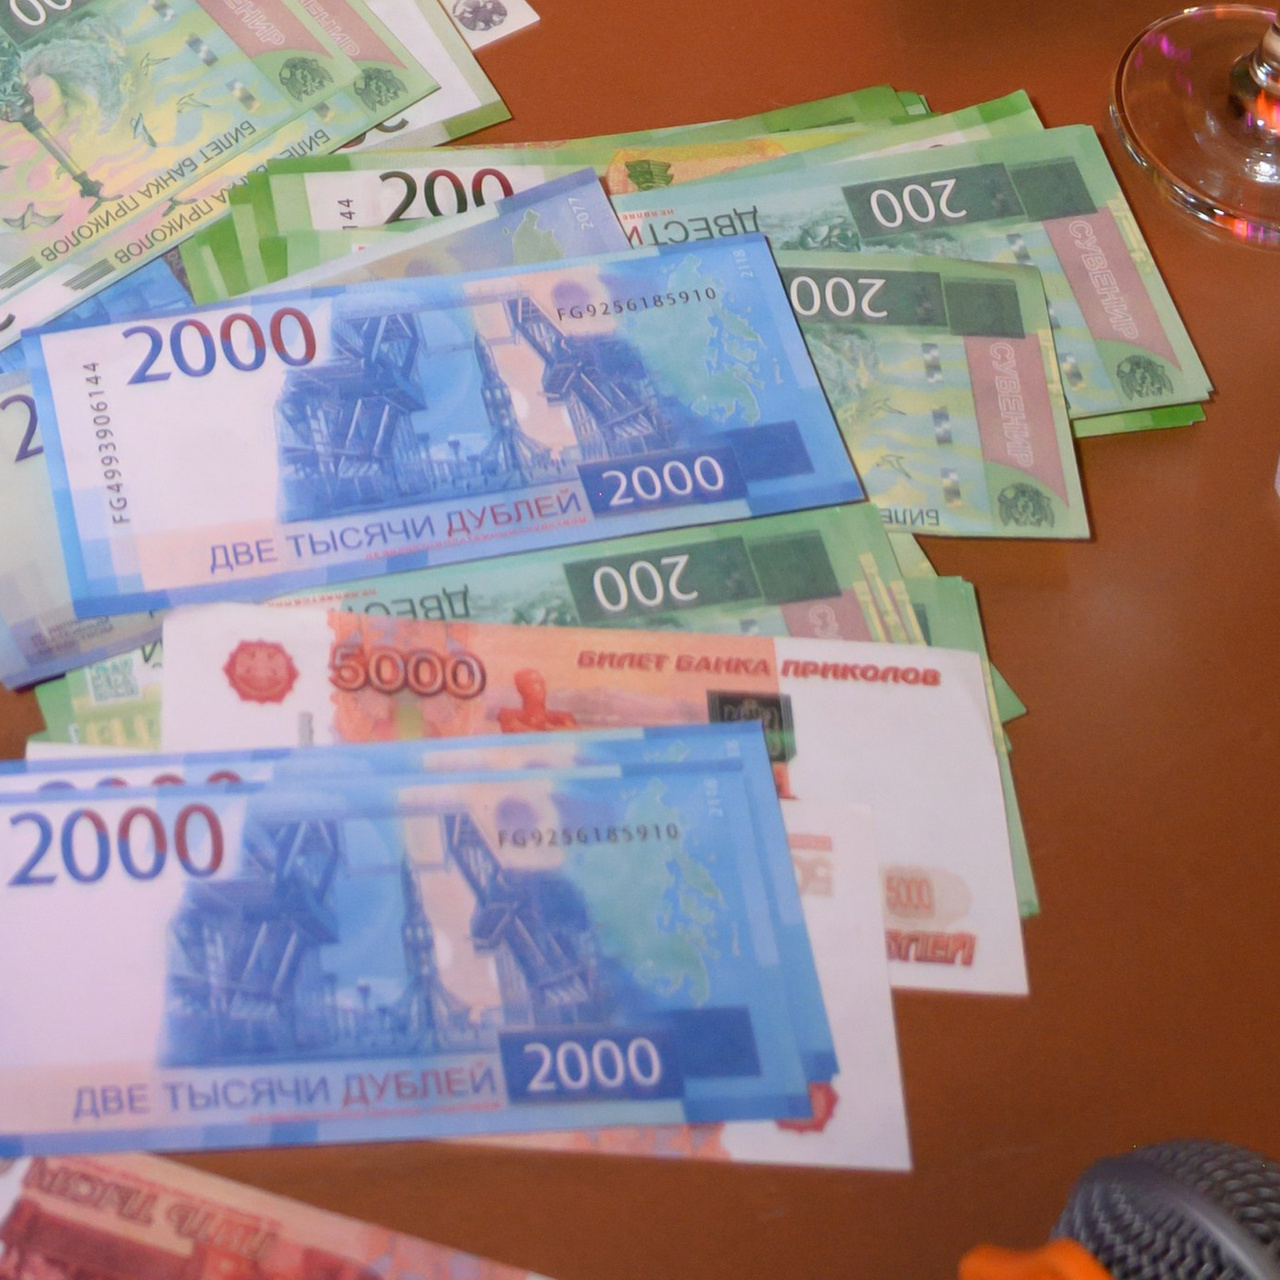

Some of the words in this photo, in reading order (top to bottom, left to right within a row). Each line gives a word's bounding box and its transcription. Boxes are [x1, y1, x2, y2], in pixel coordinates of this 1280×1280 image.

[196, 119, 257, 164] БИЛЕТ
[281, 128, 331, 160] БИЛЕ
[136, 156, 198, 199] БАНКА
[379, 168, 515, 224] 200
[870, 178, 969, 229] 200
[40, 194, 140, 264] ПРИКОЛОВ
[114, 199, 215, 265] ПРИКОЛОВ
[626, 205, 760, 248] ДВЕСТИ
[557, 287, 718, 321] FG9256185910
[790, 276, 889, 319] 200
[1069, 219, 1140, 340] СУВЕНИР
[122, 307, 316, 386] 2000
[989, 342, 1034, 468] СУВЕНИР
[83, 361, 131, 526] FG4993906144
[602, 455, 725, 507] 2000
[210, 538, 279, 574] ДВЕ
[286, 514, 436, 560] ТЫСЯЧИ
[446, 488, 582, 538] ДУБЛЕЙ
[882, 508, 940, 527] БИЛЕ
[593, 554, 700, 614] 200
[328, 640, 487, 701] 5000
[577, 649, 669, 671] БИЛЕТ
[674, 653, 770, 677] БАНКА
[780, 657, 942, 688] ПРИКОЛОВ
[6, 803, 225, 888] 2000
[73, 1084, 150, 1124] ДВЕ
[164, 1076, 330, 1113] ТЫСЯЧИ
[342, 1061, 498, 1110] ДУБЛЕЙ
[523, 1036, 662, 1093] 2000
